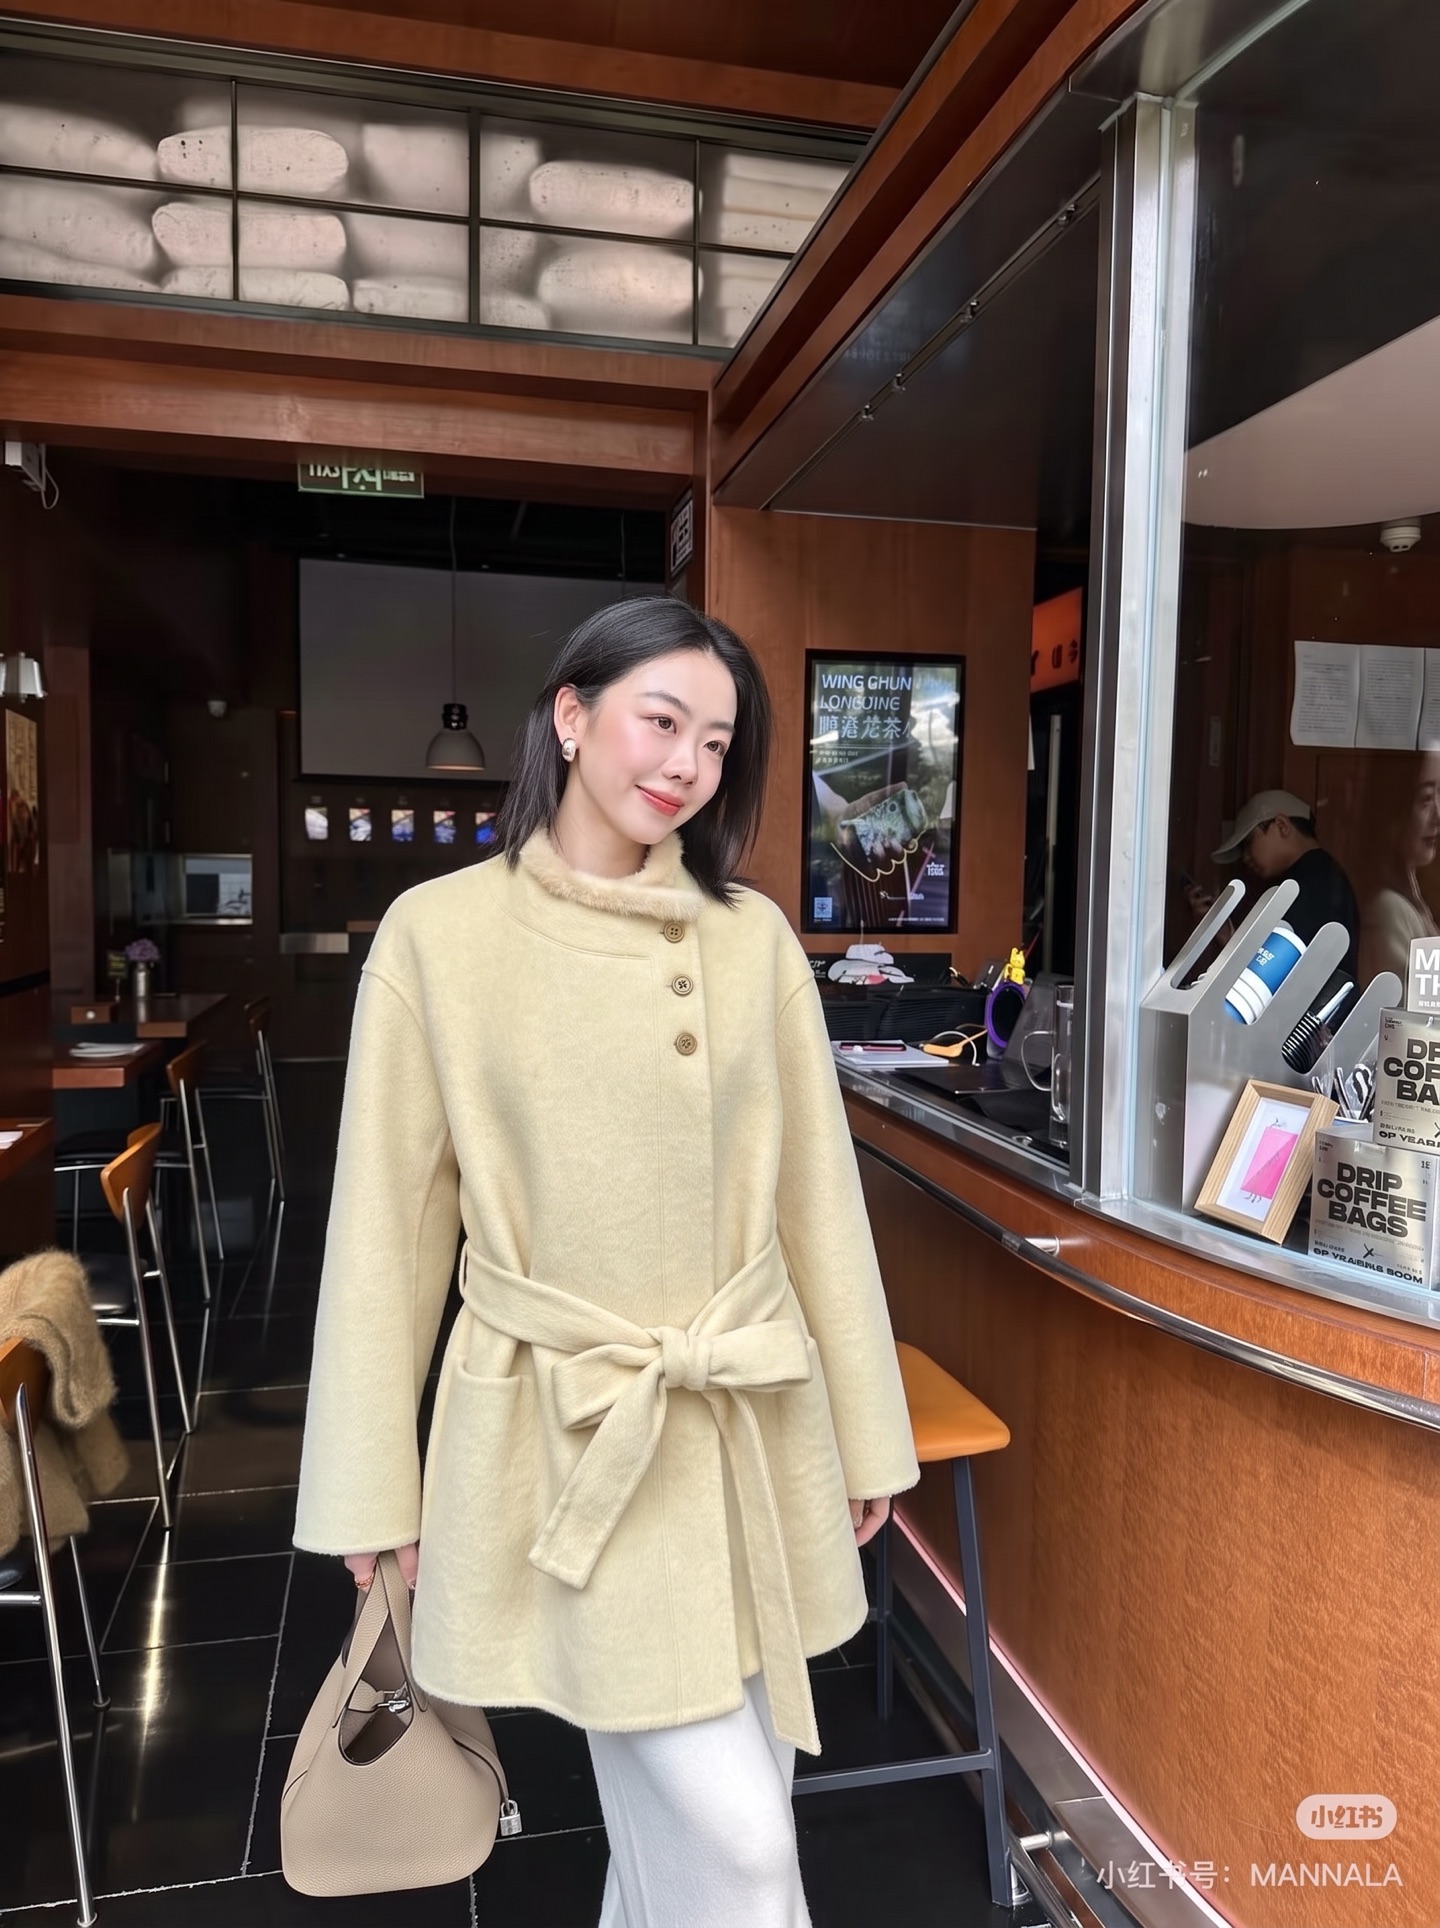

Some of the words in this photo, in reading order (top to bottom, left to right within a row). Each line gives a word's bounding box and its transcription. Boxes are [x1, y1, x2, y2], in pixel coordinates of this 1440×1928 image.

[821, 674, 864, 689] WING
[1337, 1162, 1403, 1192] DRIP
[1317, 1178, 1427, 1222] COFFEE
[1328, 1200, 1408, 1238] BAGS
